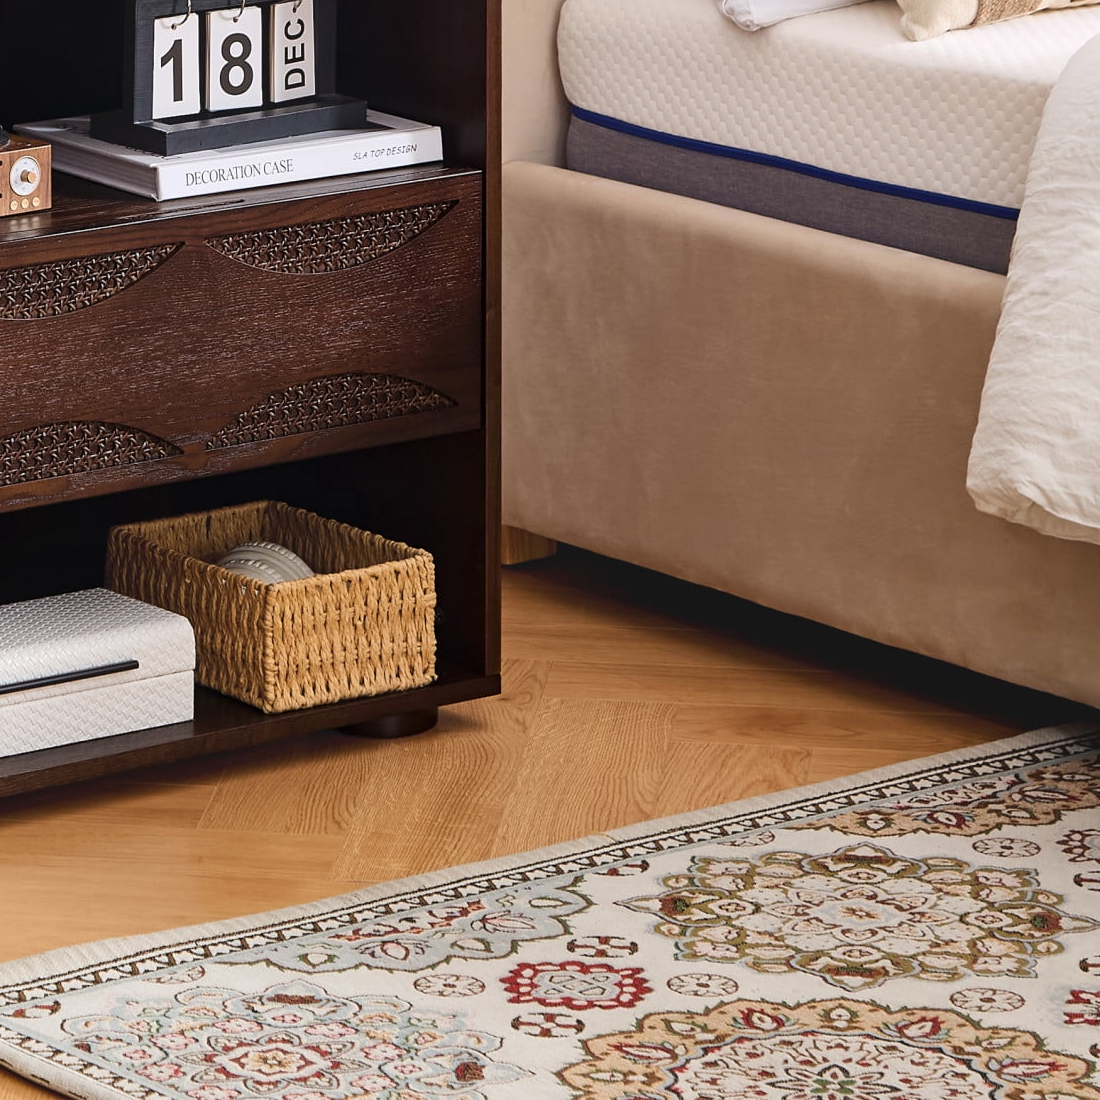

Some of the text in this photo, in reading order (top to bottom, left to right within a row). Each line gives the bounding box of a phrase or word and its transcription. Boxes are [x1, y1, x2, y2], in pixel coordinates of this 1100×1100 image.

[160, 32, 254, 102] 1 8
[284, 18, 306, 90] DEC
[185, 158, 294, 187] DECORATION CASE
[352, 144, 418, 161] SLA TOP DESIGN
